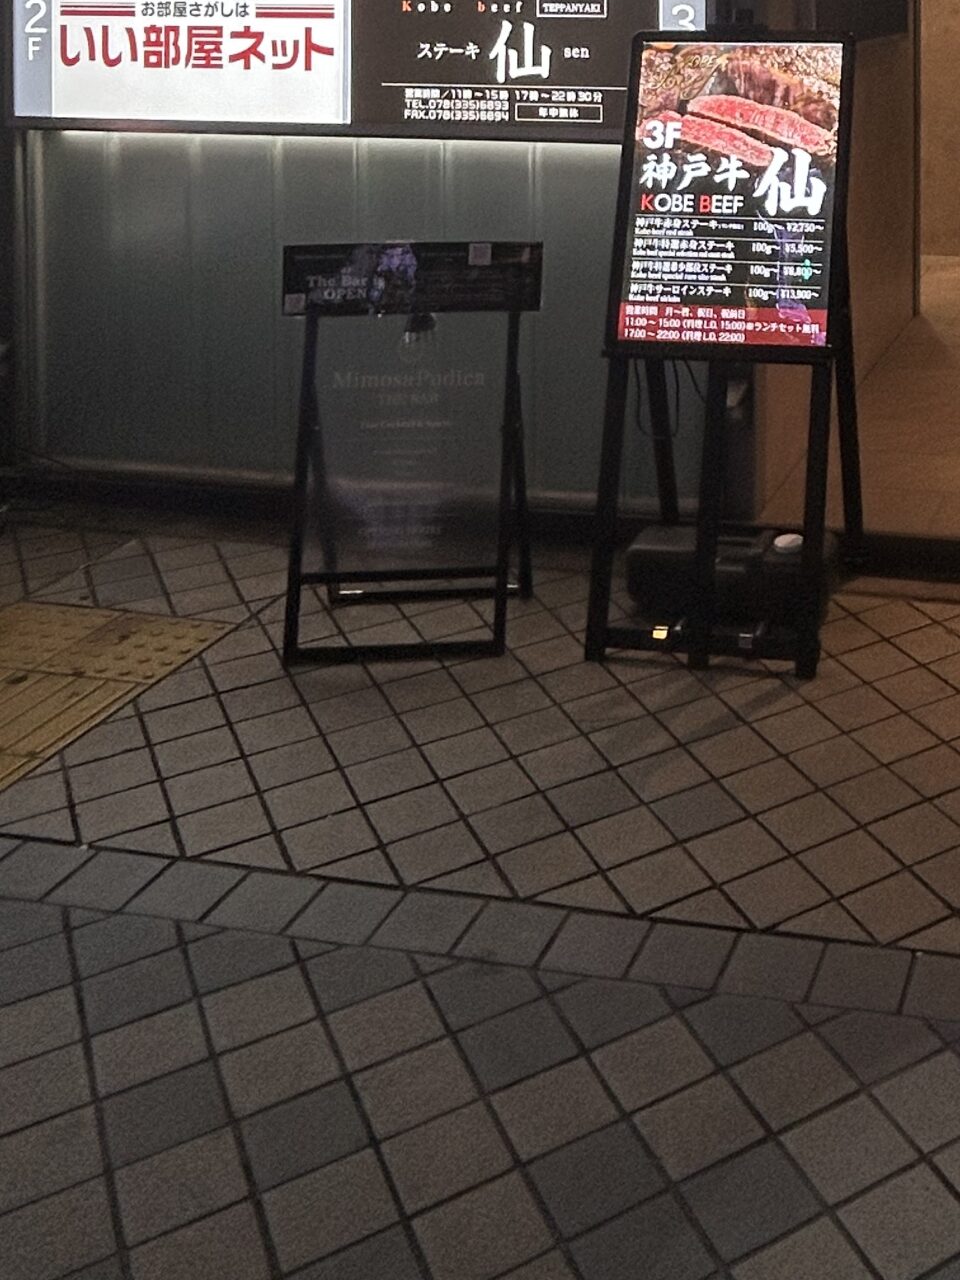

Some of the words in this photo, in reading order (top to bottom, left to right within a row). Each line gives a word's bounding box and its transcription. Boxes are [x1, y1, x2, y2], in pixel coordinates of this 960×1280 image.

[140, 1, 250, 18] お部屋さがしは
[402, 0, 452, 12] Kobe
[477, 1, 523, 13] beef
[542, 3, 601, 13] TEPPANYAKI
[59, 25, 335, 71] いい部屋ネット
[417, 42, 480, 60] ステーキ
[489, 20, 552, 84] 仙
[564, 47, 590, 59] sen
[643, 120, 682, 149] 3F
[639, 152, 751, 191] 神戸牛
[753, 148, 828, 216] 仙
[640, 194, 695, 212] KOBE
[699, 195, 744, 214] BEEF
[306, 275, 336, 288] The
[341, 274, 368, 287] Bar
[323, 288, 367, 300] OPEN
